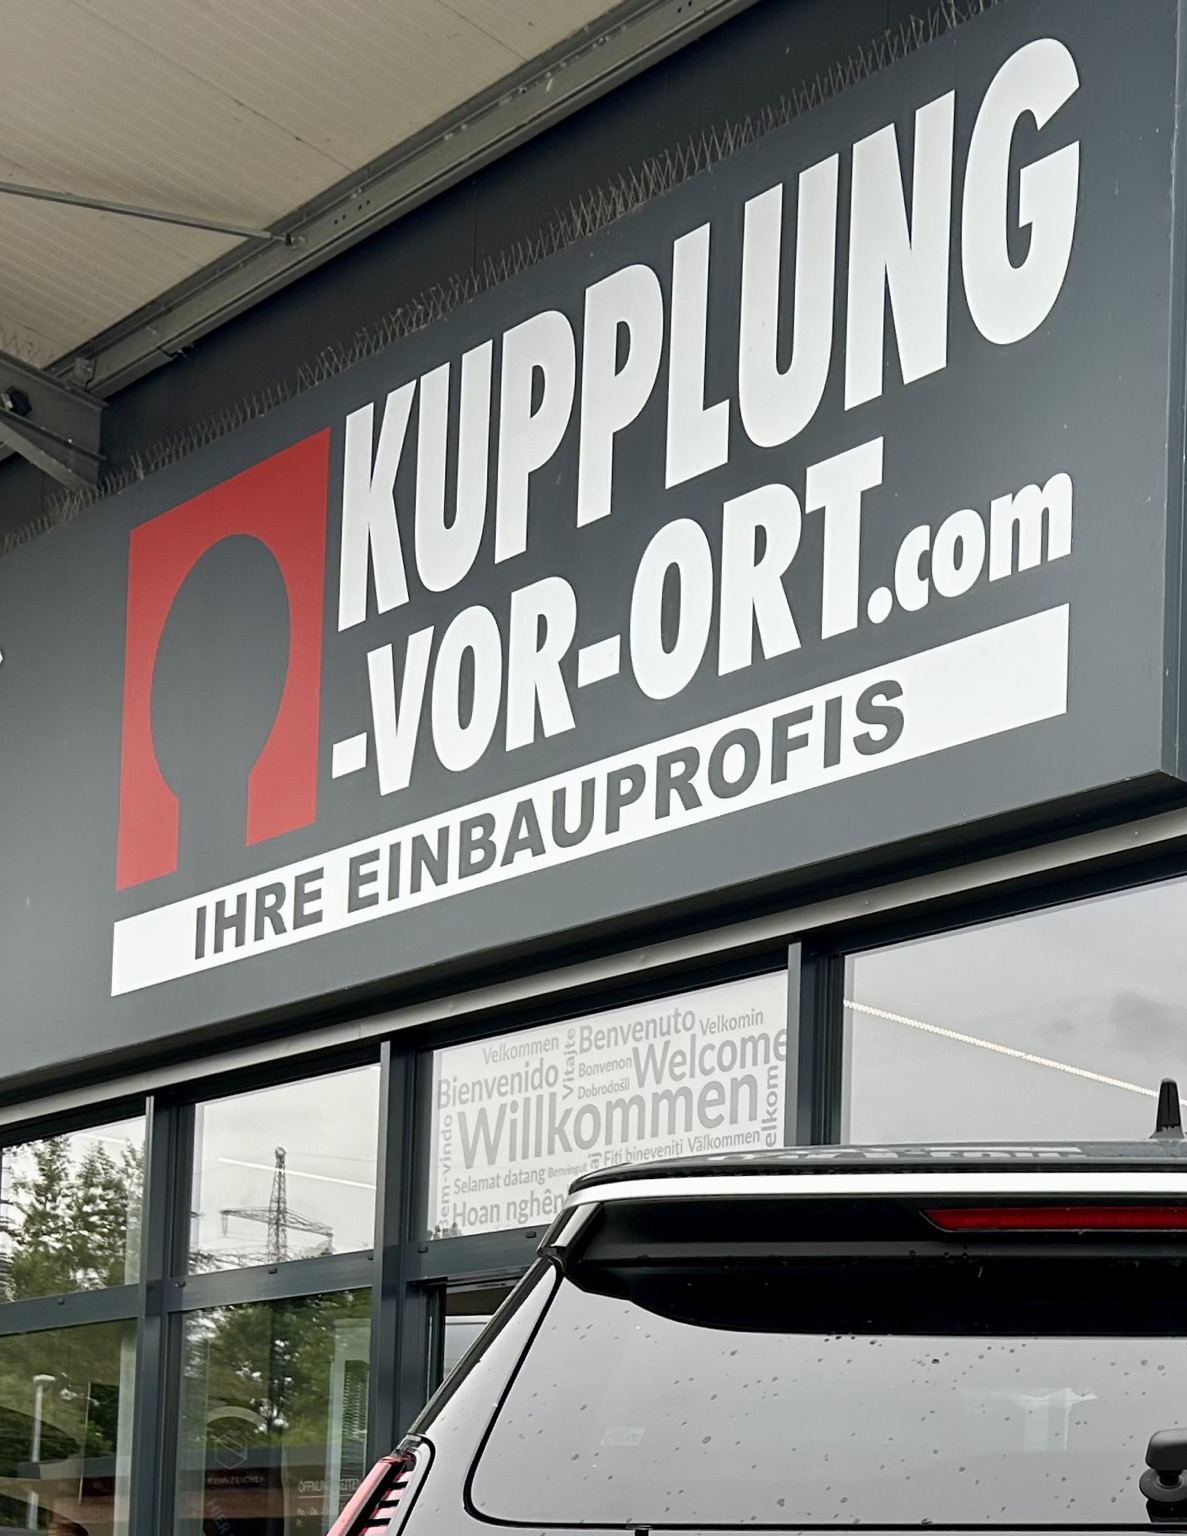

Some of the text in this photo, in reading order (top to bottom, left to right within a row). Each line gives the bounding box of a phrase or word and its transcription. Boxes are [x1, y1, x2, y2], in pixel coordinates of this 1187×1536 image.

[337, 37, 1080, 631] KUPPLUNG
[331, 436, 1073, 797] -VOR-ORT.com
[195, 679, 906, 960] IHRE EINBAUPROFIS
[579, 1007, 695, 1054] Benvenuto
[699, 1008, 764, 1036] Velkomin
[482, 1037, 559, 1065] Velkommen
[562, 1028, 578, 1100] Vitajte
[578, 1057, 632, 1078] Bonvenon
[632, 1028, 787, 1088] Welcome
[437, 1057, 559, 1109] Bienvenido
[457, 1074, 759, 1169] Willkommen
[453, 1168, 546, 1195] Selamat datang
[604, 1151, 622, 1166] Fiti
[453, 1201, 500, 1227] Hoan
